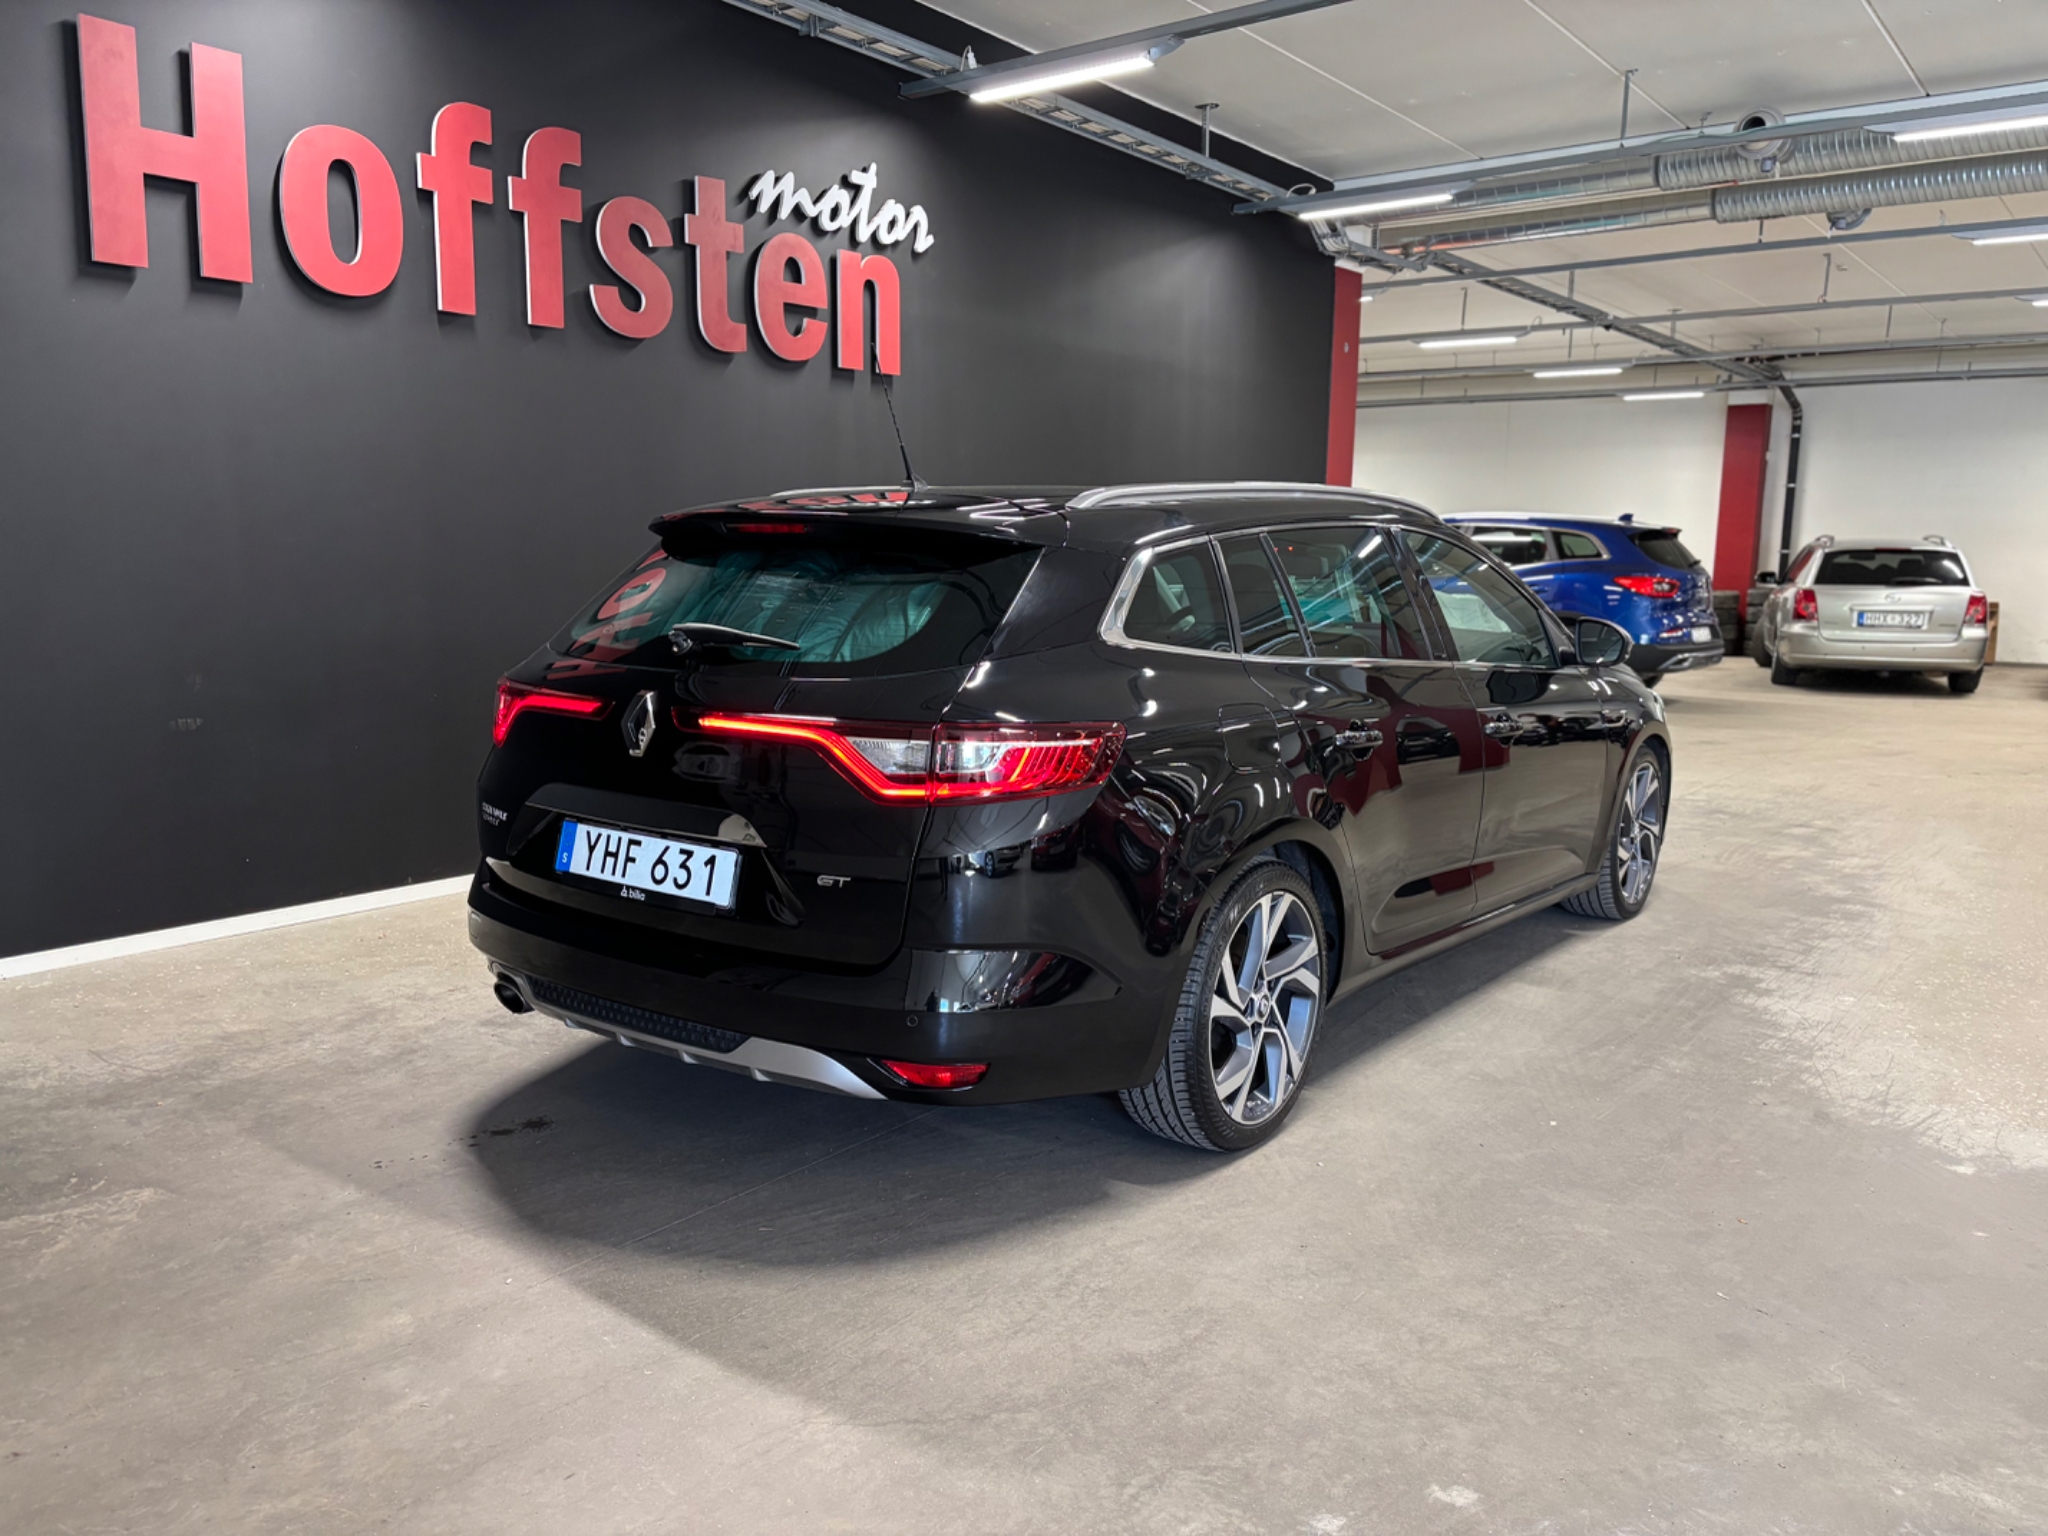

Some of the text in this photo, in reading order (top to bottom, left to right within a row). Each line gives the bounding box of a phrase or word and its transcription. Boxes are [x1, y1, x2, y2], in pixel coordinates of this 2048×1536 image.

[77, 12, 902, 377] Hoffsten
[749, 161, 935, 254] motor
[561, 851, 569, 864] S
[586, 829, 717, 897] YHF 631
[816, 874, 851, 889] GT
